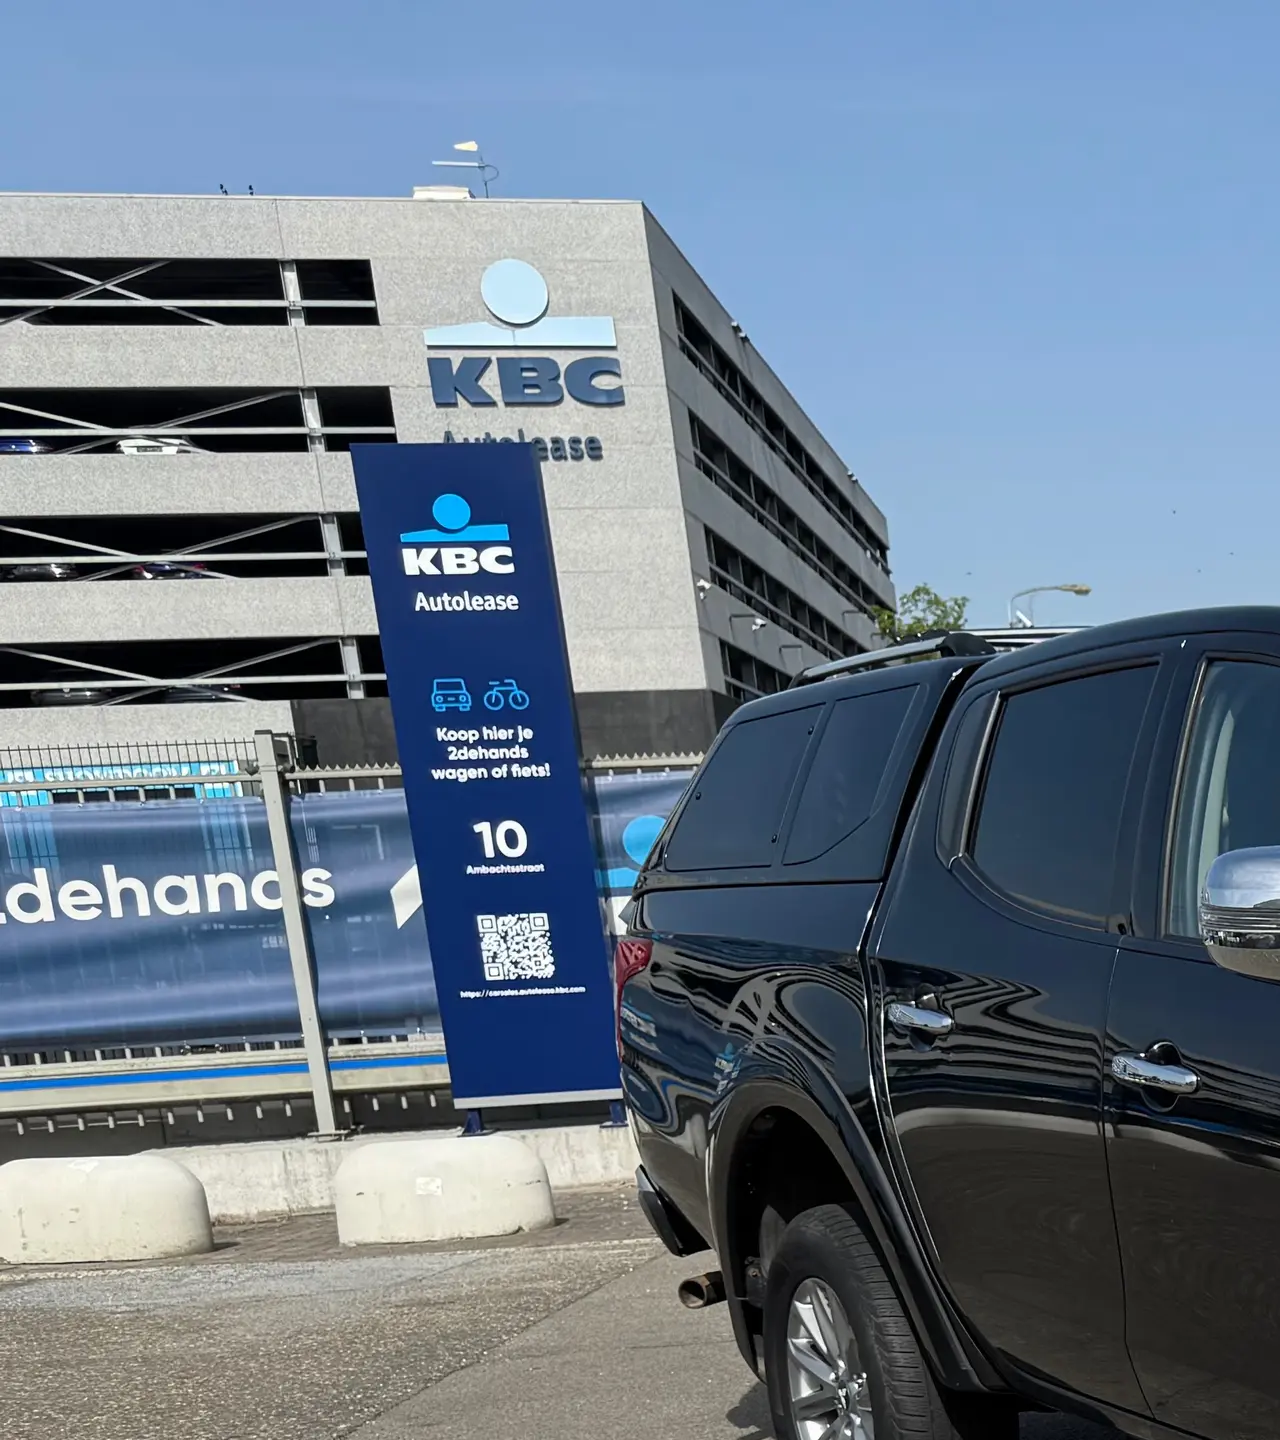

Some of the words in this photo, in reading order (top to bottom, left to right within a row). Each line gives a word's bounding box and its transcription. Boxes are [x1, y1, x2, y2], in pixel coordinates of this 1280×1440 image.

[427, 356, 626, 408] KBC
[443, 428, 604, 462] lease
[402, 546, 515, 576] KBC
[415, 590, 520, 611] Autolease
[436, 726, 480, 744] Koop
[482, 725, 514, 740] hier
[517, 725, 534, 743] je
[447, 744, 529, 760] 2dehands
[431, 767, 488, 782] wagen
[491, 764, 508, 778] of
[511, 762, 551, 777] fiets!
[473, 820, 528, 858] 10
[466, 863, 545, 875] Ambachtsstraat
[0, 864, 335, 925] dehans
